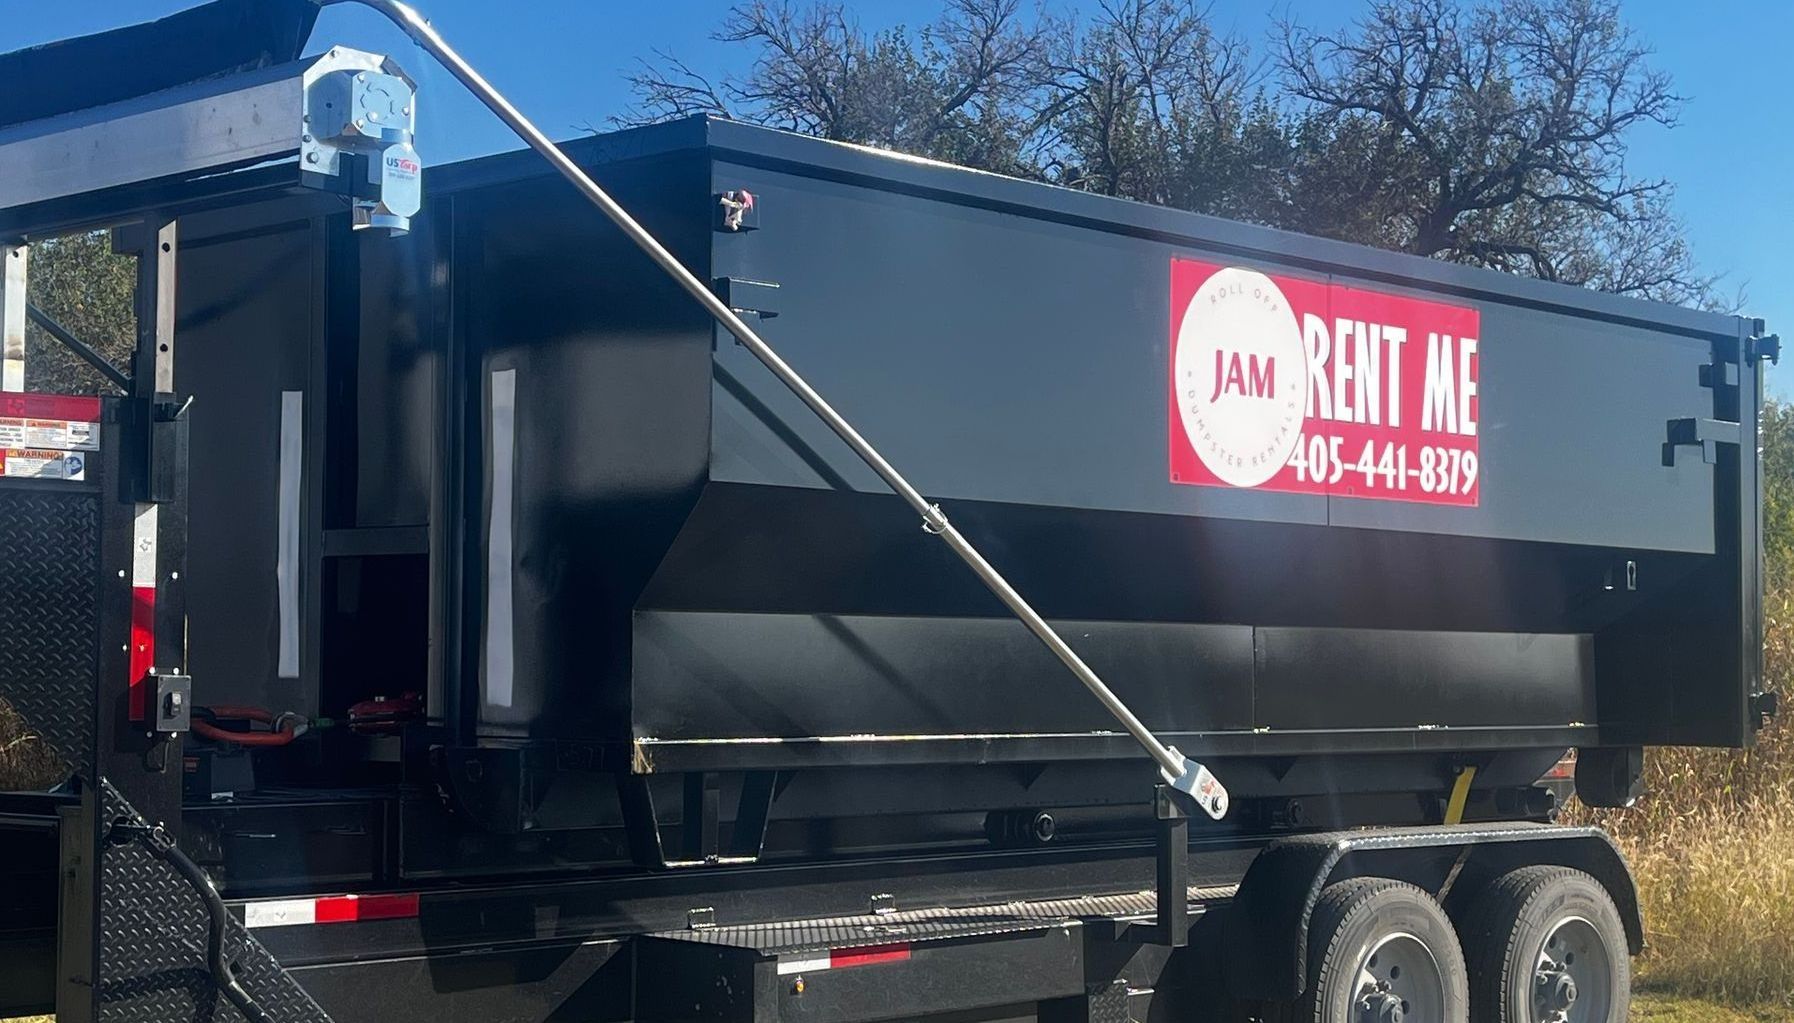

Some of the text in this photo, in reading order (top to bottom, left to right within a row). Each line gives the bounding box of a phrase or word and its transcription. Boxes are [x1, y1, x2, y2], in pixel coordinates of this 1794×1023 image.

[1210, 282, 1279, 312] ROLL OFF
[1210, 349, 1275, 404] JAM
[1303, 312, 1478, 436] RENT ME
[1188, 390, 1295, 468] DUMPSTER RENTALS
[1286, 433, 1478, 496] 405-441-8379
